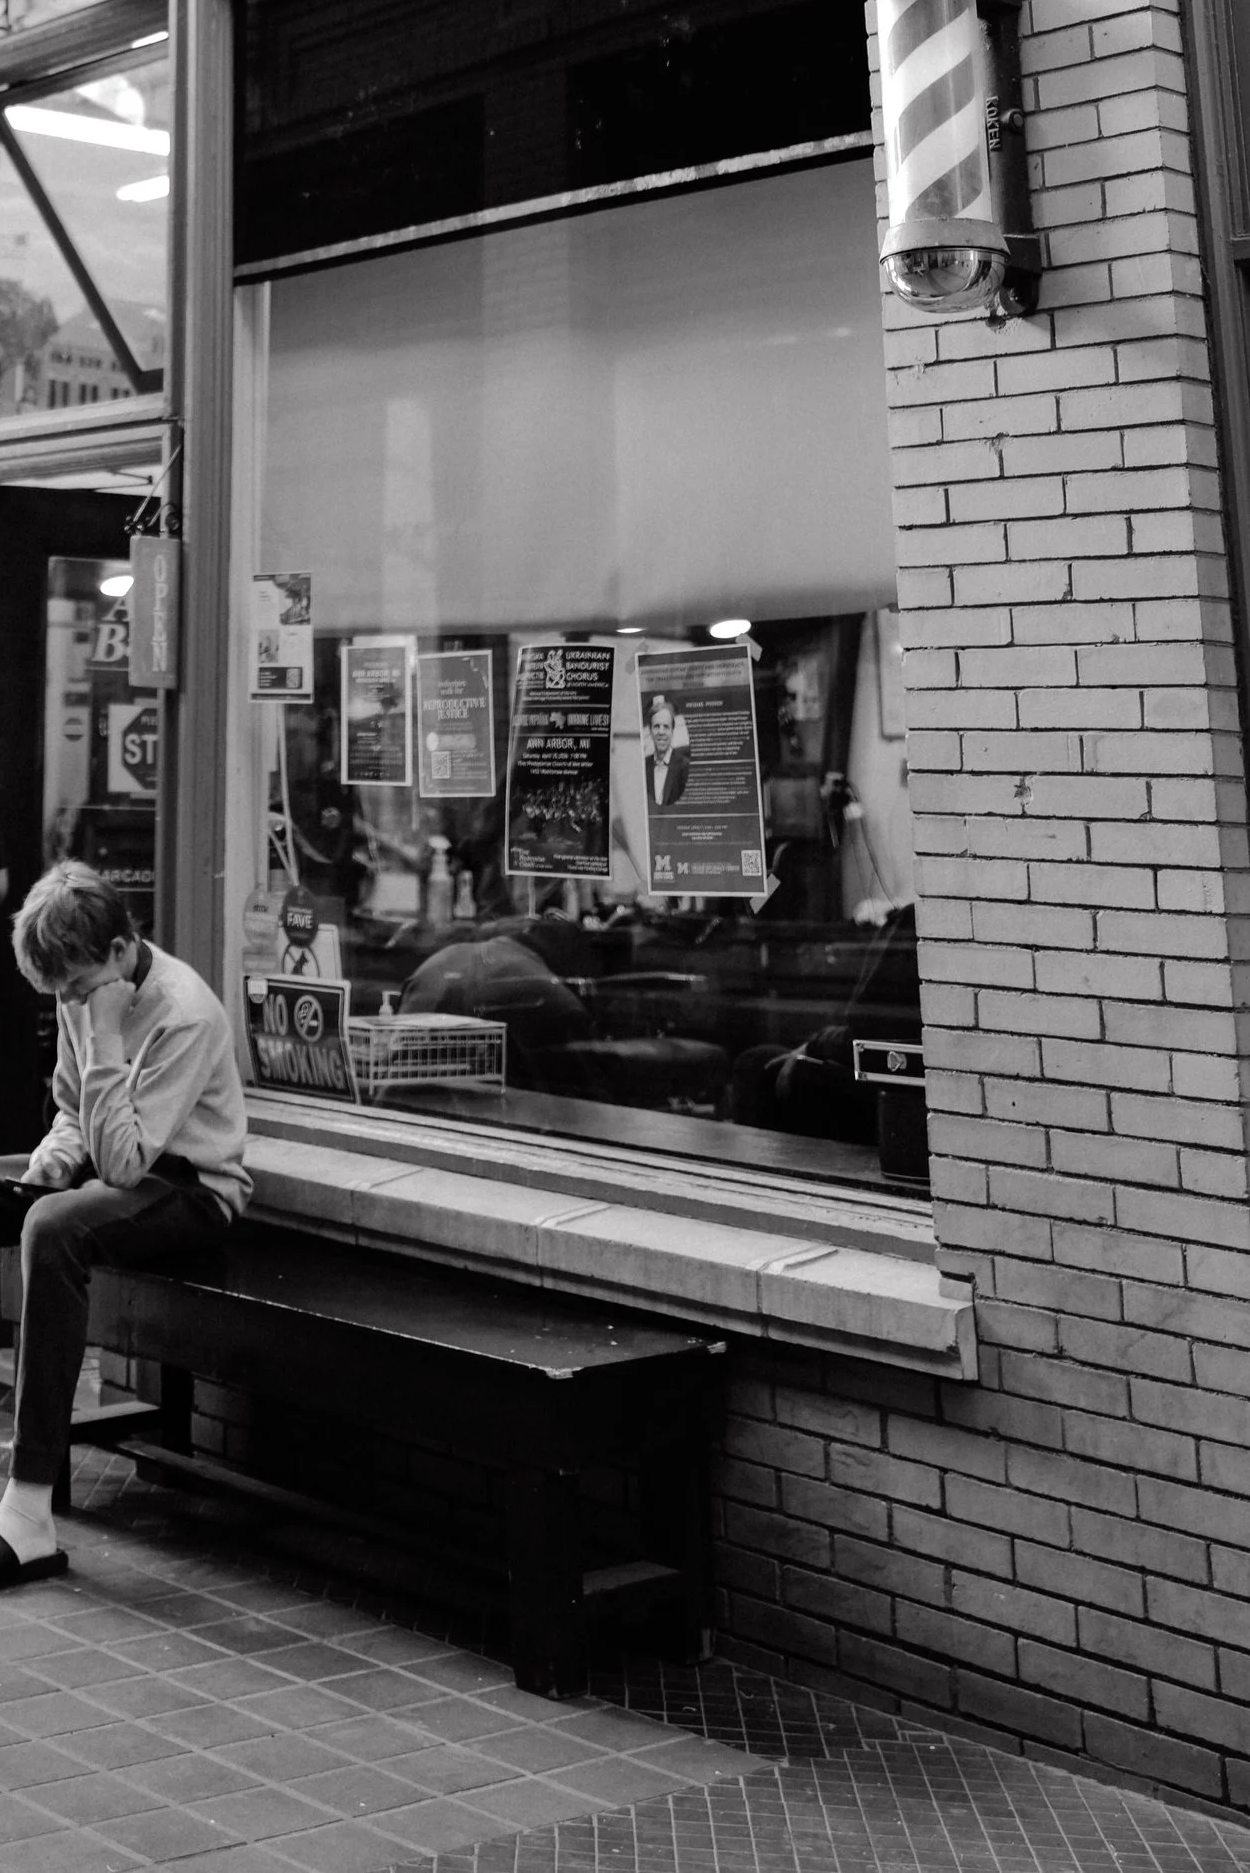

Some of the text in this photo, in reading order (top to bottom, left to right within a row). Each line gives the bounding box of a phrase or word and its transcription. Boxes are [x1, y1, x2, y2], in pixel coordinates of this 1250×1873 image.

[986, 95, 1002, 149] KOKEN
[151, 554, 169, 672] OPEN
[124, 733, 158, 765] ST
[287, 912, 314, 929] FAVE
[263, 994, 288, 1036] NO
[257, 1038, 345, 1089] SMOKING
